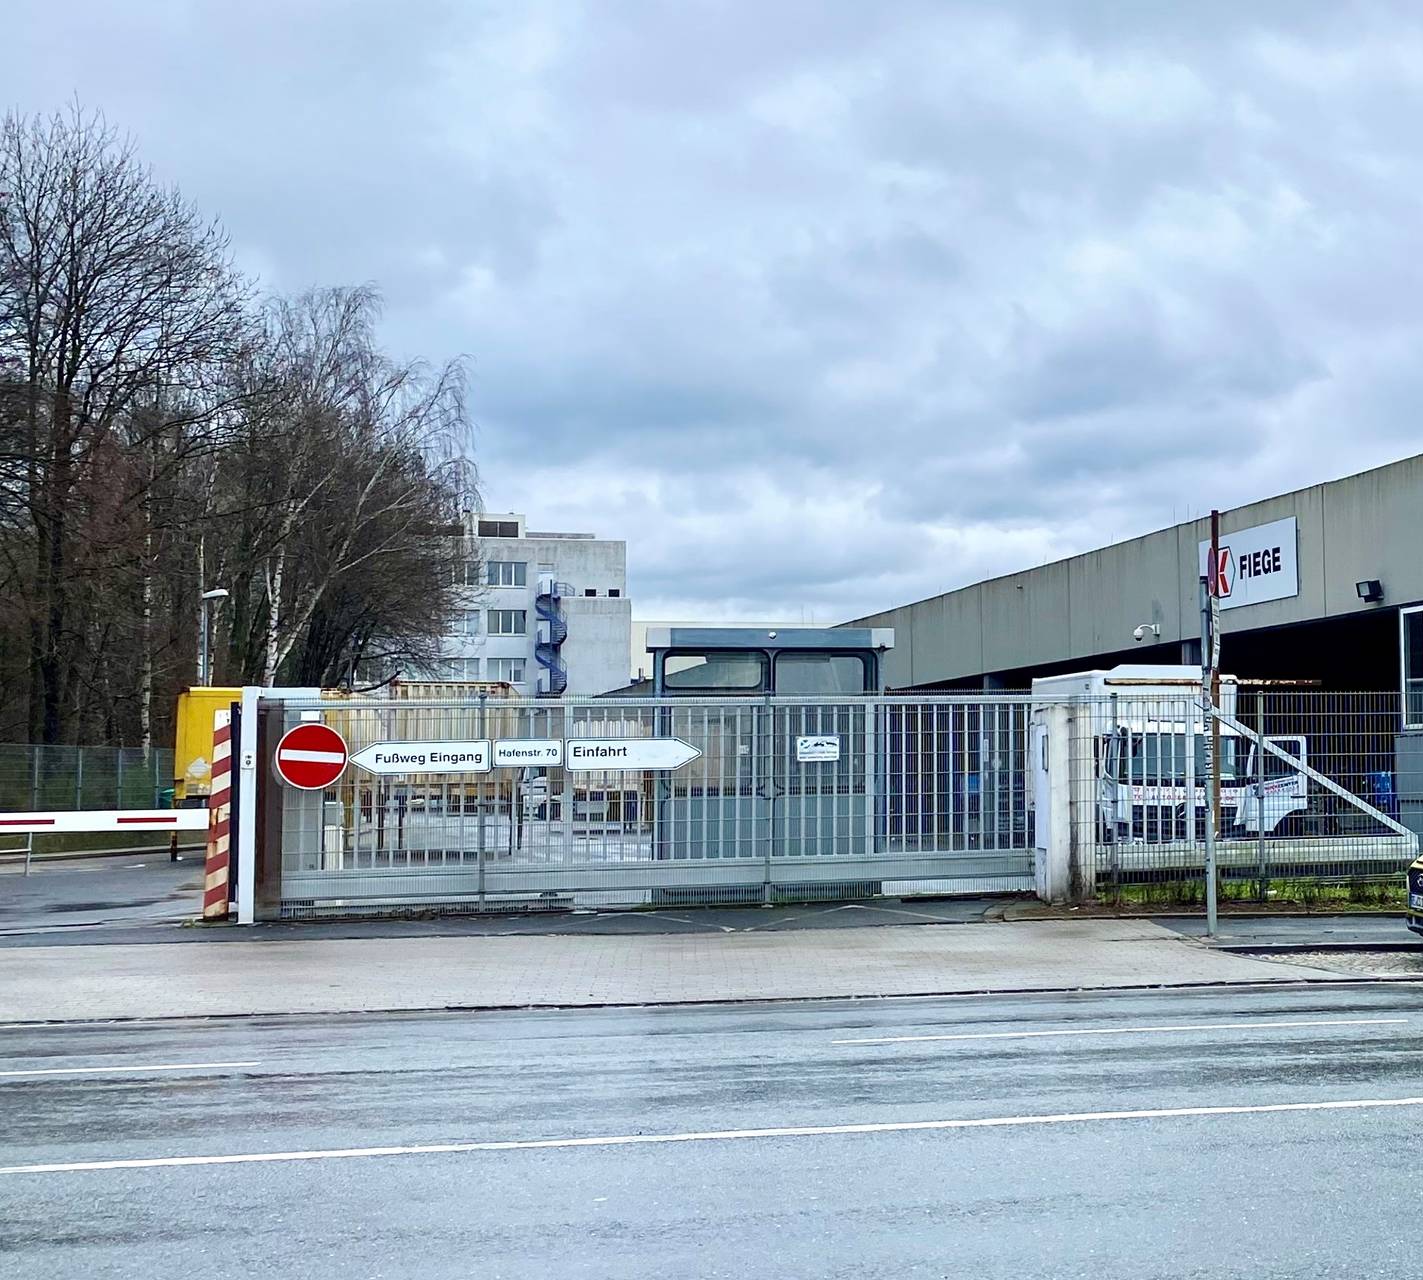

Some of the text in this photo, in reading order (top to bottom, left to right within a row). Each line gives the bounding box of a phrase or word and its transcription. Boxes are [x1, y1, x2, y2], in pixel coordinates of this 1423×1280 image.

[1239, 547, 1281, 580] FIEGE
[498, 748, 558, 757] Hafenstr. 70
[573, 746, 627, 757] Einfahrt
[375, 752, 482, 765] Fußweg Eingang
